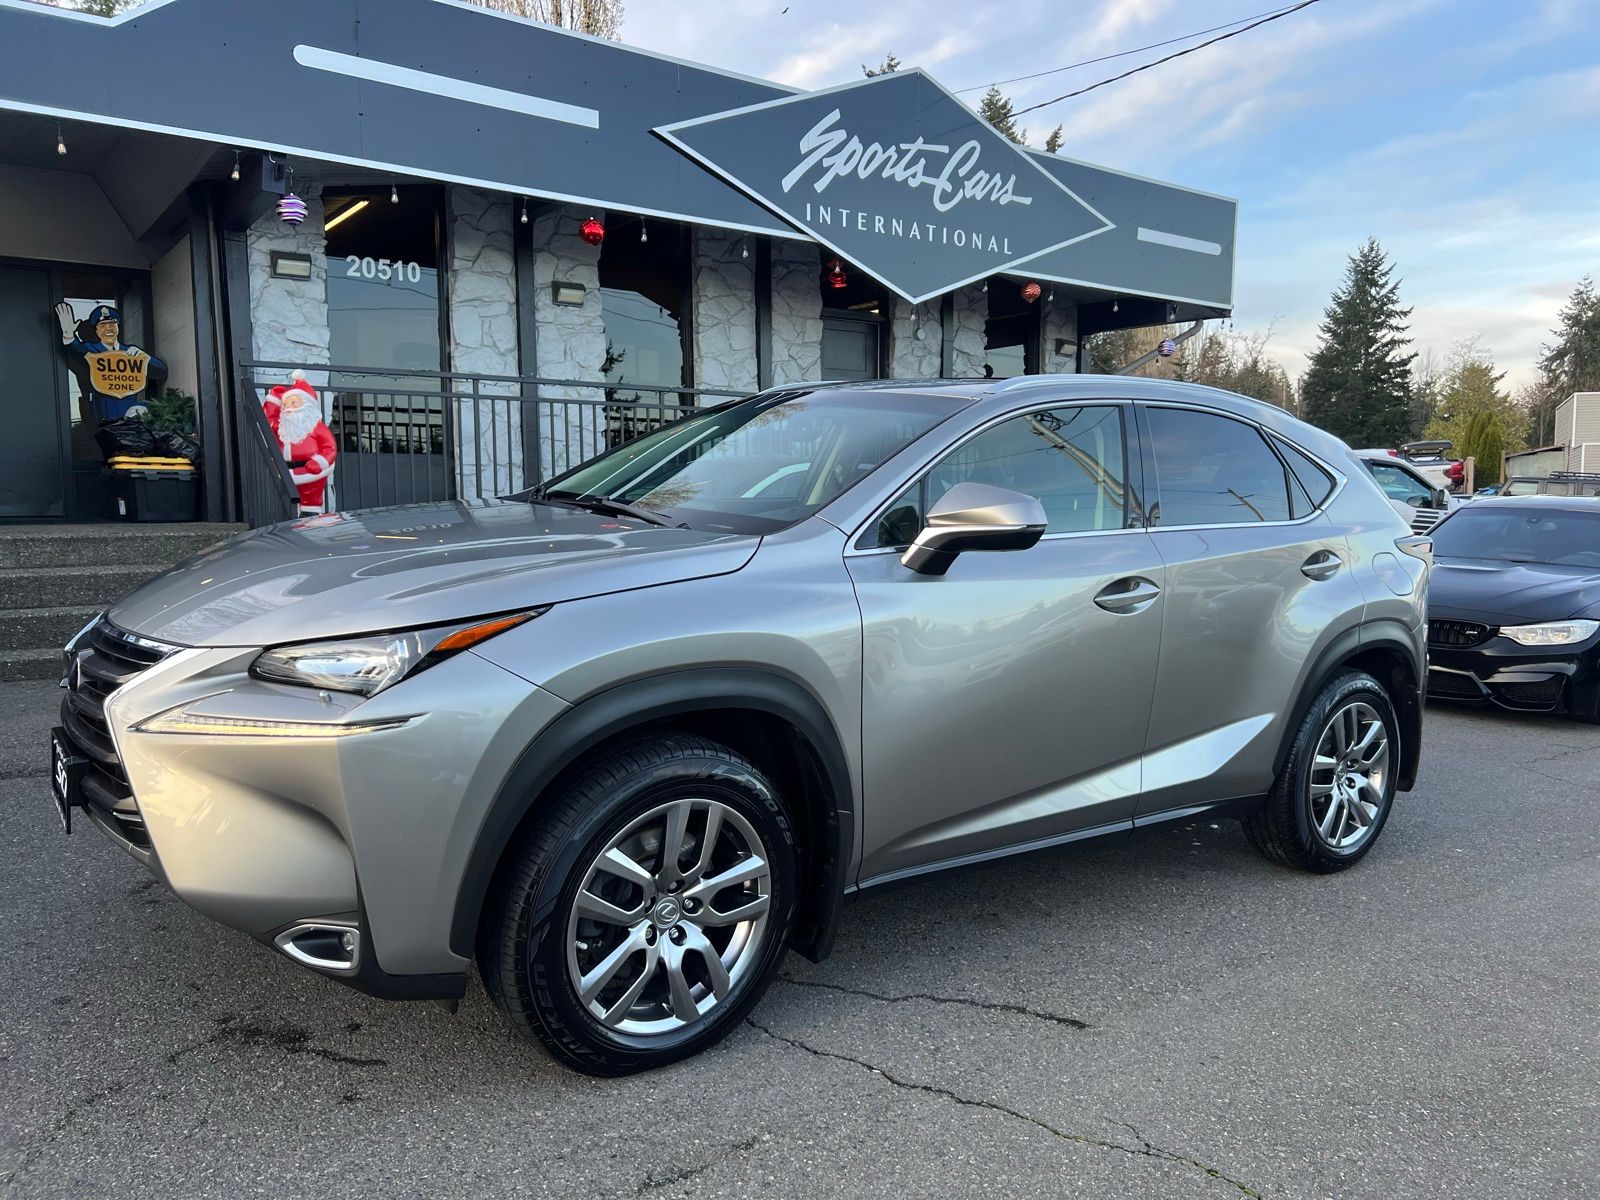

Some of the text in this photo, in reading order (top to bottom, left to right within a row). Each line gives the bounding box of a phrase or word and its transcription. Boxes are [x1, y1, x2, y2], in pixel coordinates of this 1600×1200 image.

[781, 108, 1033, 212] Sports Cars
[806, 203, 1012, 255] INTERNATIONAL
[346, 254, 421, 283] 20510
[96, 357, 144, 374] SLOW
[101, 374, 141, 383] SCHOOL
[108, 383, 135, 391] ZONE
